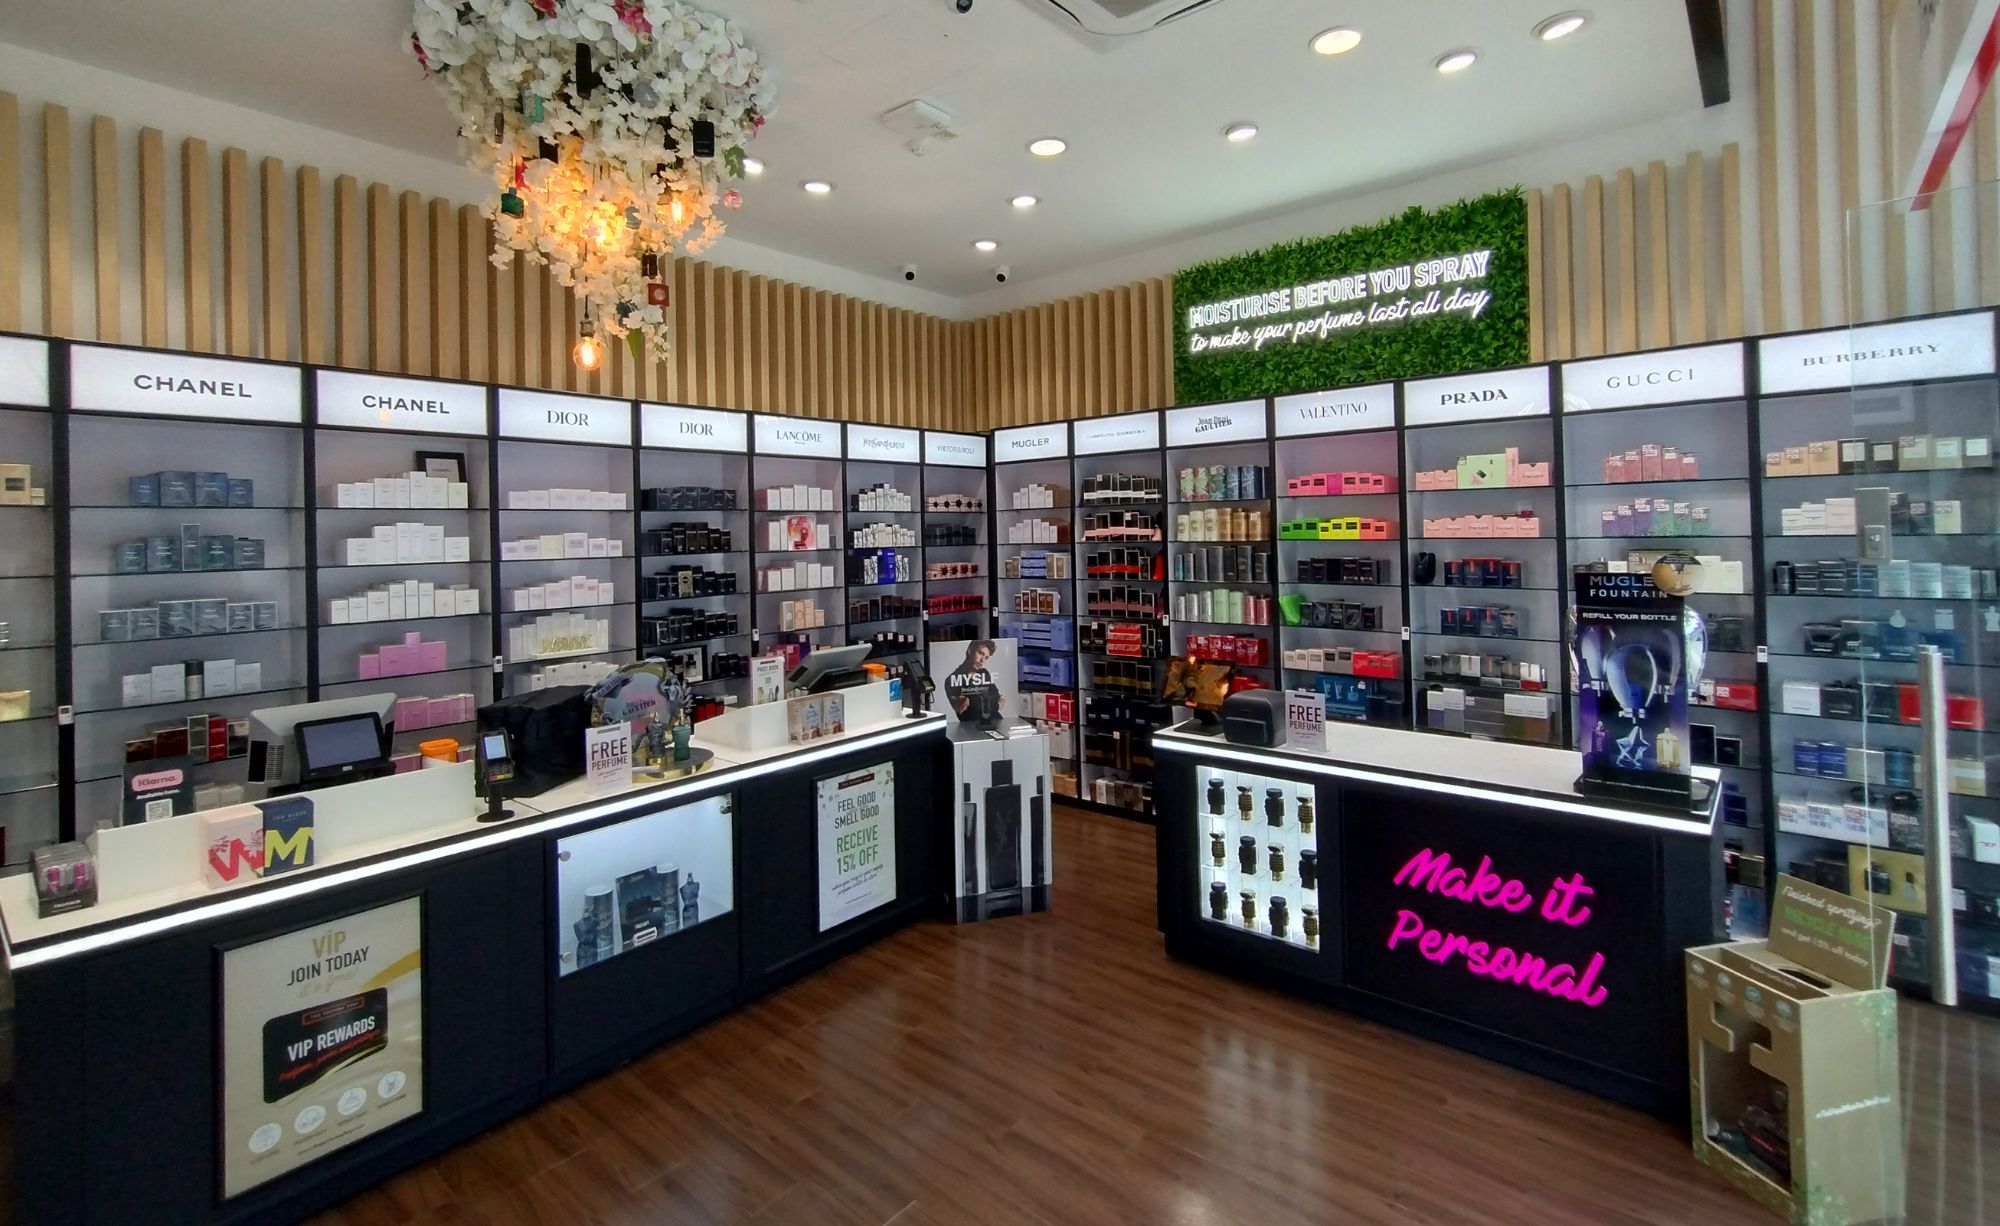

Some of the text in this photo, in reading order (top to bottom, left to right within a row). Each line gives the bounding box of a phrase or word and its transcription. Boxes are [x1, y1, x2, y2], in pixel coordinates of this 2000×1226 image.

[1190, 251, 1491, 329] MOISTURISE BEFORE YOU SPRAY
[1191, 289, 1490, 354] to make your perfume last all day
[1802, 343, 1940, 367] BURBERRY
[133, 374, 253, 398] CHANEL
[1607, 368, 1694, 389] GUCCI
[362, 394, 451, 415] CHANEL
[1440, 387, 1508, 405] PRADA
[547, 409, 590, 427] DIOR
[1299, 401, 1368, 421] VALENTINO
[679, 421, 713, 437] DIOR
[1195, 418, 1232, 433] GAULTIER
[776, 430, 823, 443] LANCÔME
[1011, 437, 1050, 449] MUGLER
[1590, 574, 1654, 588] MUGLE
[1590, 588, 1668, 599] FOUNTAIN
[1582, 611, 1677, 621] REFILL YOUR BOTTLE
[950, 672, 999, 687] MYSLF
[1289, 704, 1322, 723] FREE
[1289, 720, 1322, 732] PERFUME
[591, 737, 628, 761] FREE
[591, 755, 628, 771] PERFUME
[837, 791, 876, 813] FEEL GOOD
[834, 805, 879, 830] SMELL GOOD
[836, 824, 879, 854] RECEIVE
[836, 844, 879, 875] 15% OFF
[1393, 848, 1594, 926] Make it
[312, 930, 346, 959] VIP
[287, 962, 321, 986] JOIN
[325, 946, 369, 973] TODAY
[1387, 909, 1608, 1007] Personal
[287, 1038, 313, 1062] VIP
[317, 1016, 375, 1051] REWARDS
